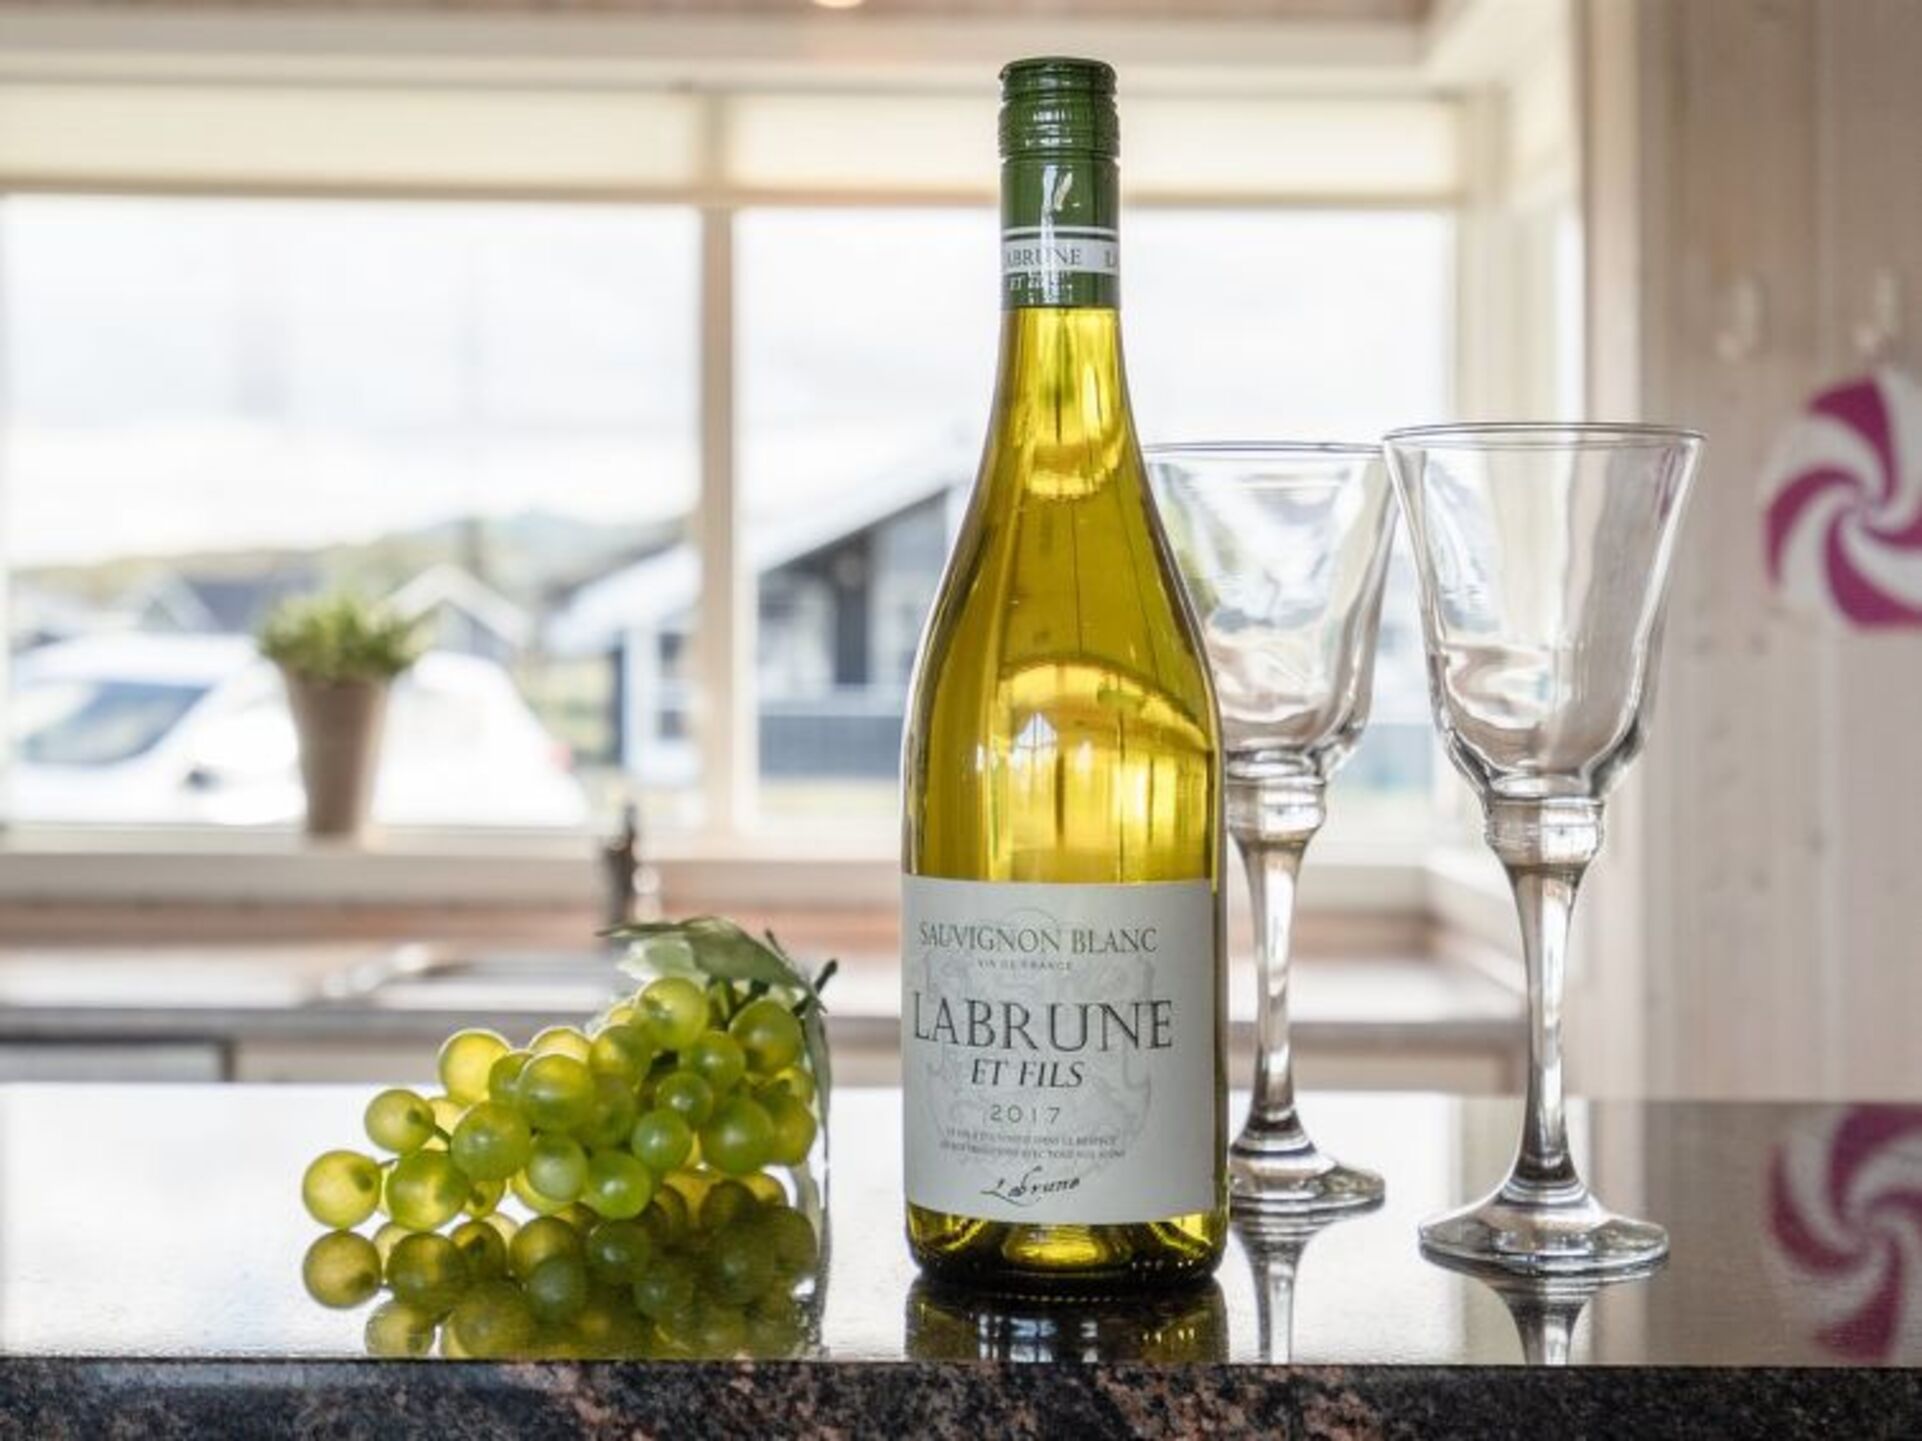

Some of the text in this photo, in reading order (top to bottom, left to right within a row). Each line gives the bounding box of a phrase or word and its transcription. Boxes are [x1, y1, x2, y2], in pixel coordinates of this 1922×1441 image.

[918, 921, 1158, 955] SAUVIGNON BLANC
[913, 991, 1173, 1052] LABRUNE
[971, 1058, 1086, 1089] ET FILS
[989, 1104, 1061, 1125] 2017
